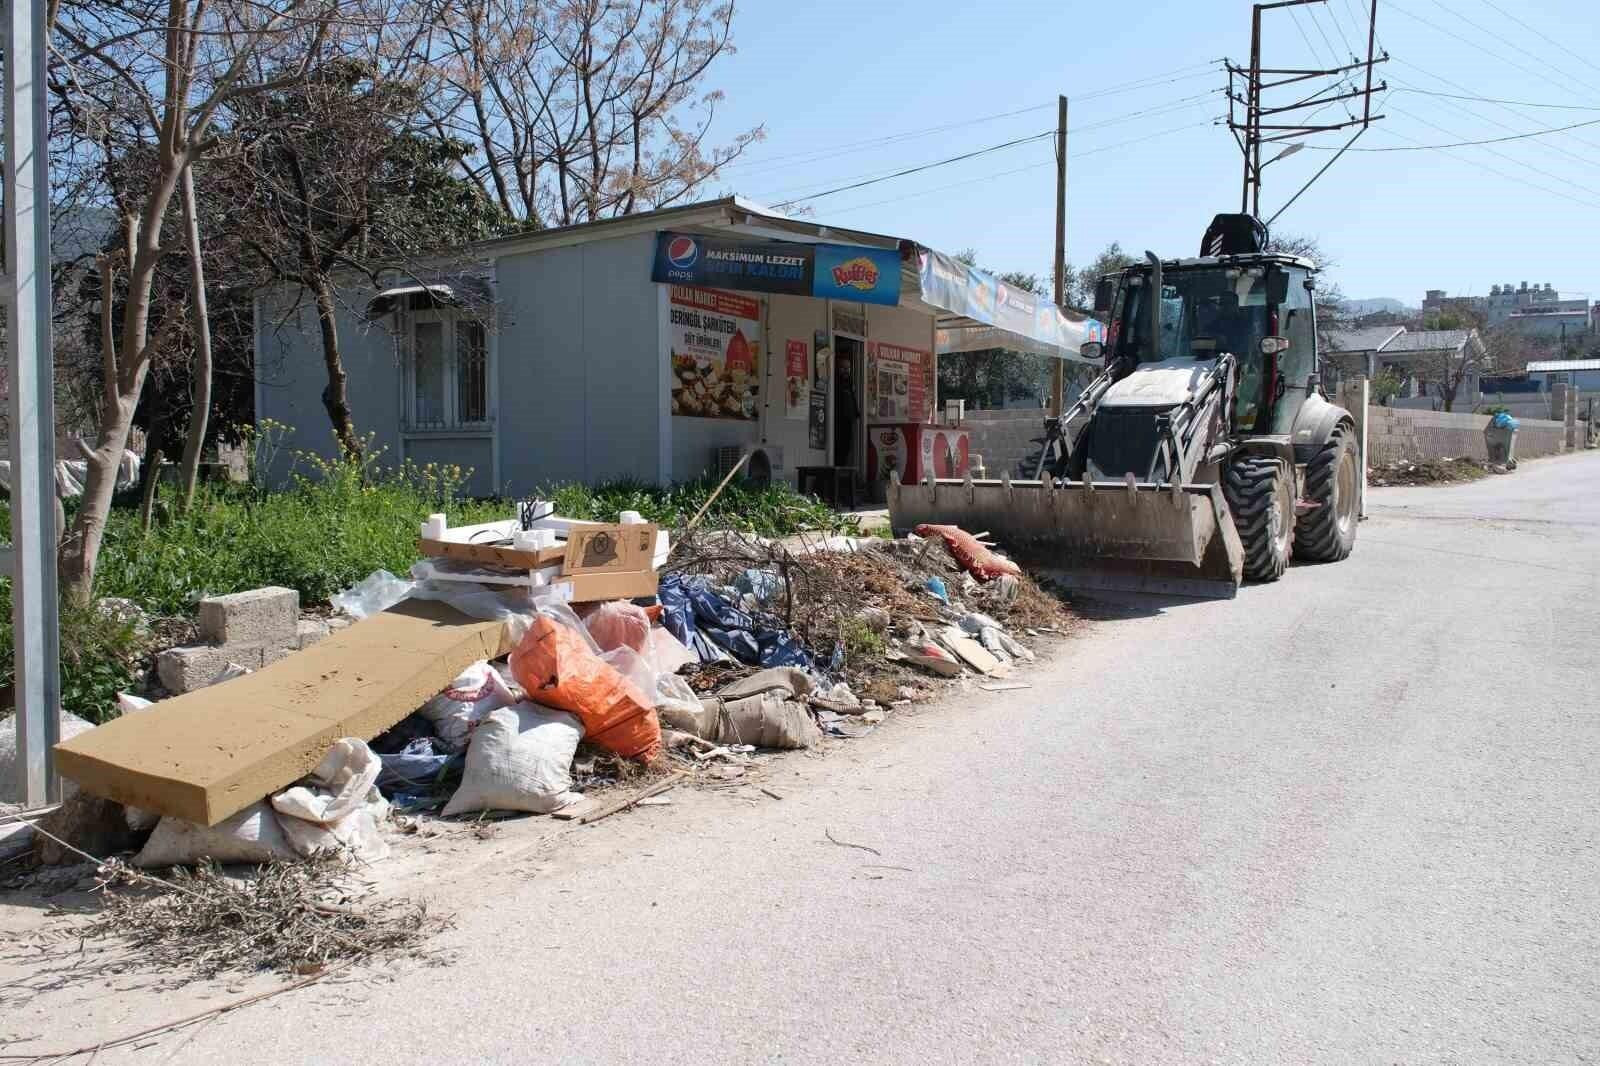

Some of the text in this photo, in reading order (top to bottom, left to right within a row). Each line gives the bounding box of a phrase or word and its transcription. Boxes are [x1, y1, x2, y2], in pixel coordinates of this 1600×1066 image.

[766, 255, 806, 266] LEZZET
[668, 270, 693, 280] pepsi
[832, 264, 878, 286] Ruffles
